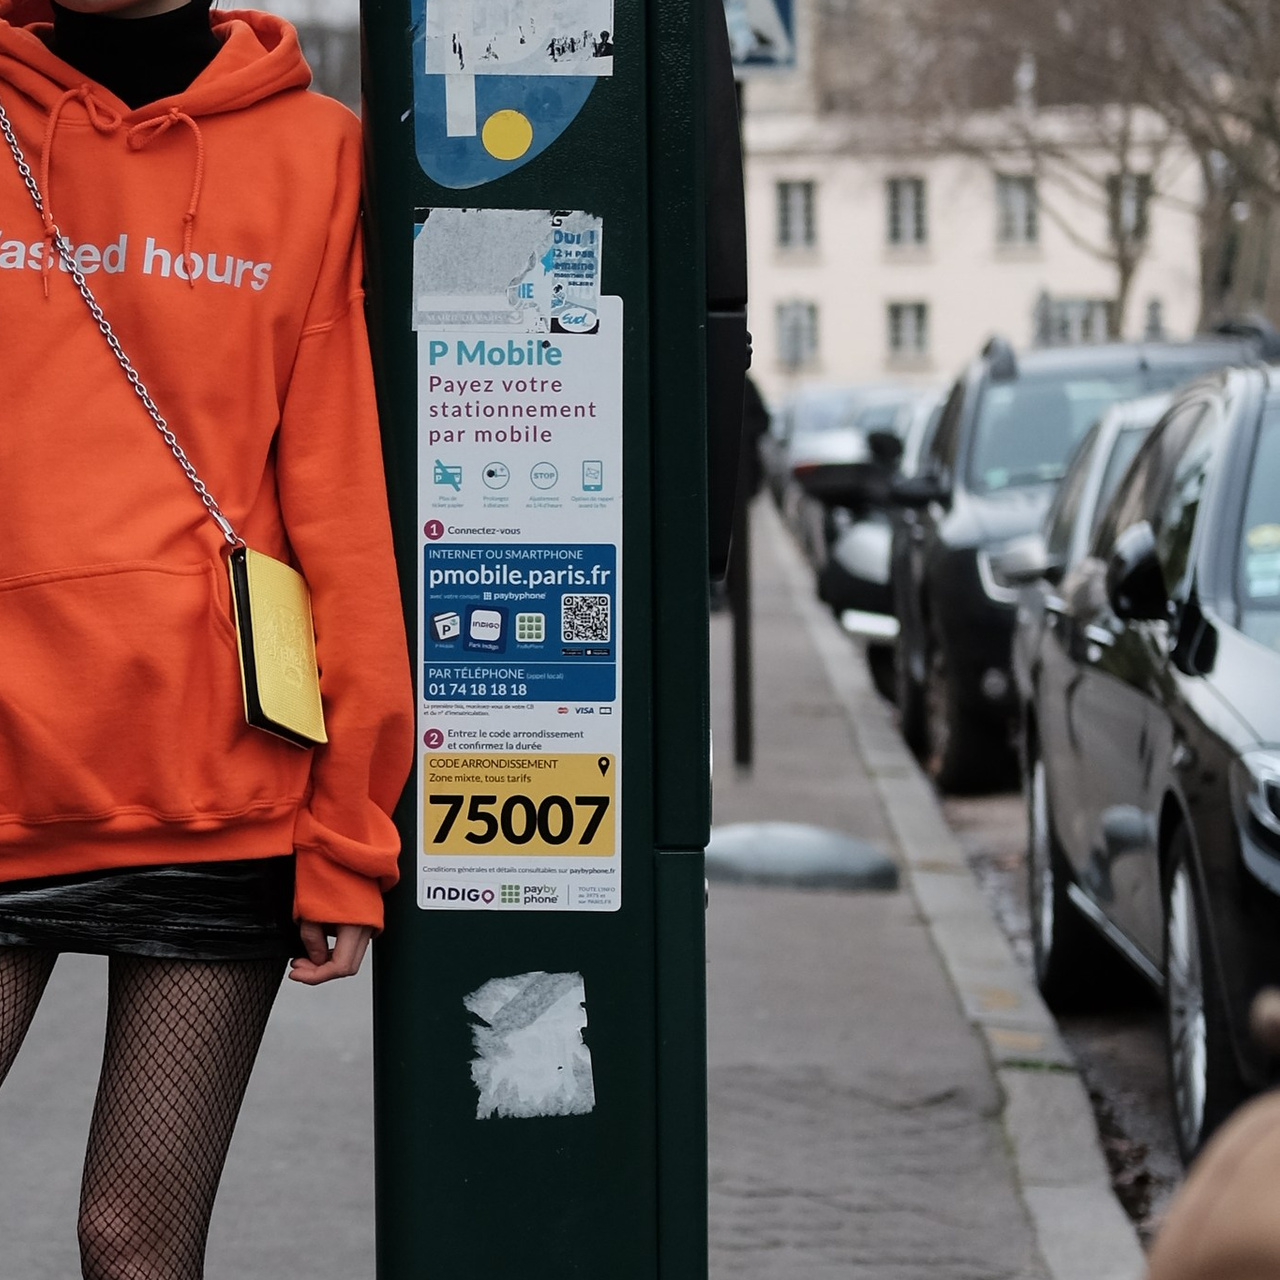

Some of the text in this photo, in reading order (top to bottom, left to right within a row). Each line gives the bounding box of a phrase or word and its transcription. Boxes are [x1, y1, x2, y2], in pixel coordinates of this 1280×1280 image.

[143, 237, 273, 291] hours
[429, 340, 563, 366] P Mobile
[429, 376, 563, 396] Payez votre
[429, 401, 597, 418] stationnement
[429, 425, 553, 446] par mobile
[533, 472, 555, 480] STOP
[431, 524, 521, 536] 1 Connectez-vous
[429, 550, 583, 560] INTERNET OU SMARTPHONE
[429, 564, 611, 589] pmobile.paris.fr
[493, 592, 546, 601] paybyphone
[442, 624, 451, 636] P
[429, 669, 452, 679] PAR
[454, 666, 525, 679] TÉLÉPHONE
[429, 684, 528, 696] 01 74 18 18 18
[430, 733, 438, 745] 2
[448, 729, 584, 738] Entrez le code arrondissement
[459, 741, 503, 750] confirmez
[506, 741, 514, 750] la
[516, 741, 542, 750] durée
[429, 759, 558, 769] CODE ARRONDISSEMENT
[429, 773, 532, 783] Zone mixte, tous tarifs
[429, 794, 611, 845] 75007
[570, 867, 616, 875] paybyphone.fr
[426, 886, 495, 904] INDIGO
[524, 885, 557, 895] payby
[524, 895, 557, 905] phone
